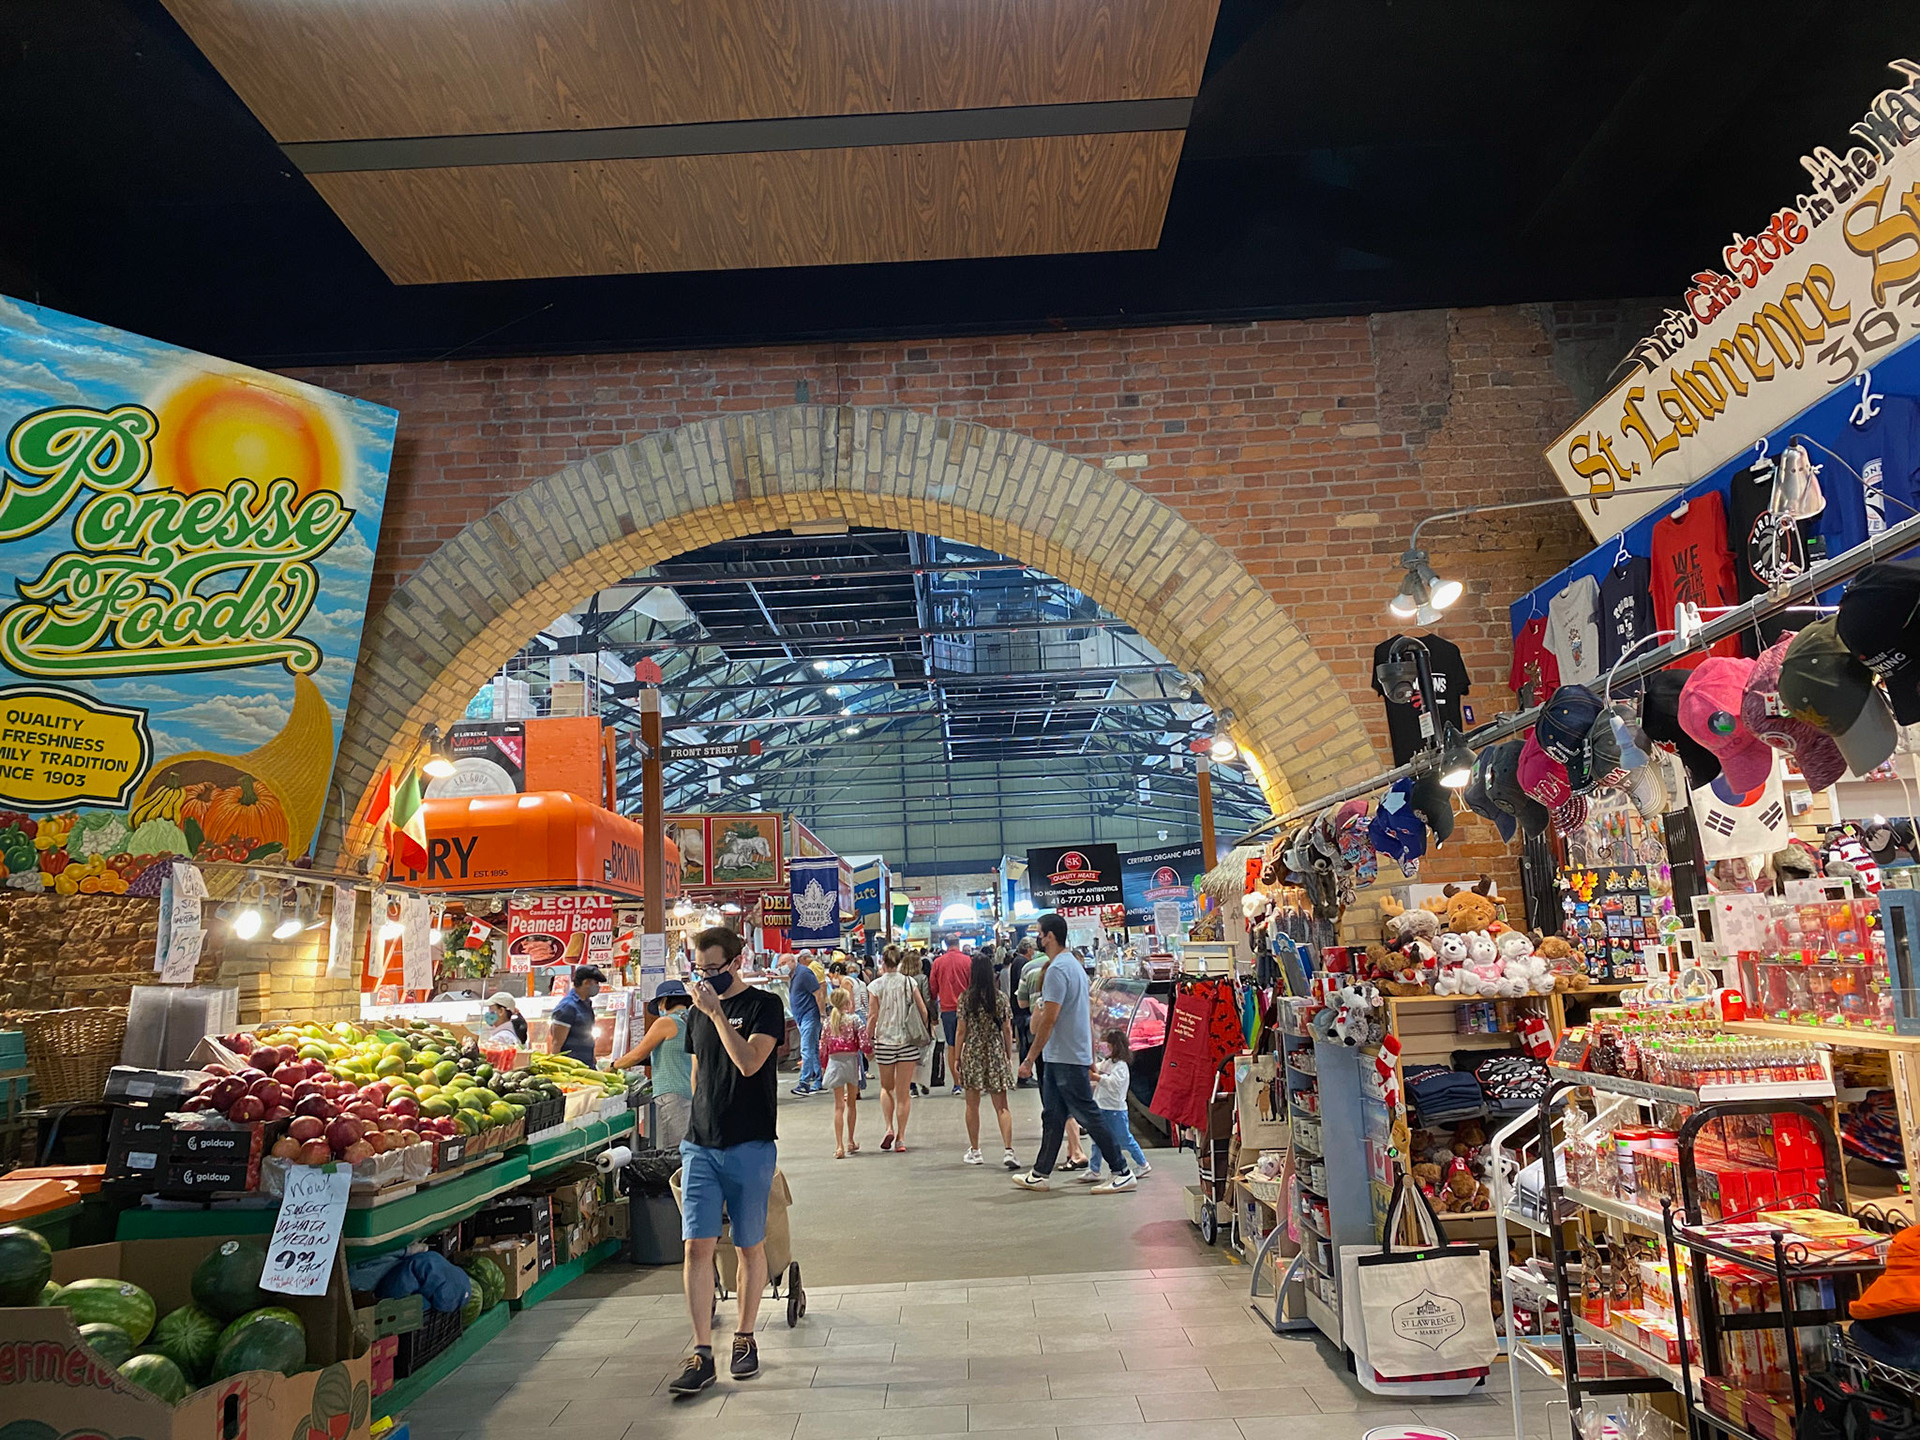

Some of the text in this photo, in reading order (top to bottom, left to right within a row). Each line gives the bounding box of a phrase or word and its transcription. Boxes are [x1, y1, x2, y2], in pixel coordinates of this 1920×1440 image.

[1725, 211, 1808, 289] Store
[1798, 195, 1835, 228] in
[1819, 148, 1877, 204] the
[1569, 430, 1641, 515] St.
[1621, 263, 1851, 469] Lawrence
[0, 404, 355, 557] Ponesse
[1672, 543, 1700, 574] WE
[10, 546, 318, 670] Foods
[7, 710, 85, 731] QUALITY
[2, 729, 104, 752] FRESHNESS
[670, 745, 739, 758] FRONT STREET
[40, 751, 128, 773] TRADITION
[0, 765, 86, 787] NCE 1903
[470, 773, 488, 785] GOOD
[611, 840, 641, 885] BROWN
[1066, 857, 1080, 866] SK
[1127, 848, 1201, 865] CERTIFIED ORGANIC MEATS
[473, 869, 509, 878] EST. 1895
[1053, 872, 1076, 882] QUALITY
[1159, 873, 1171, 881] SK
[854, 888, 877, 900] ure
[1045, 888, 1075, 896] HORMONES
[1086, 885, 1119, 893] ANTIBIOTICS
[510, 896, 612, 910] SPECIAL
[764, 895, 791, 910] DEL
[1051, 894, 1105, 905] 416-777-0181
[802, 902, 829, 911] TORONTO
[1056, 904, 1123, 918] BERETTA
[510, 914, 612, 933] Peameal Bacon
[591, 935, 611, 945] ONLY
[1588, 1077, 1596, 1085] Tax
[1642, 1088, 1660, 1097] No Tax
[200, 1139, 235, 1149] goldcup
[196, 1173, 230, 1182] goldcup
[1625, 1212, 1642, 1224] No Tax
[1411, 1314, 1457, 1327] LAWRENCE
[1607, 1341, 1623, 1355] No Tax
